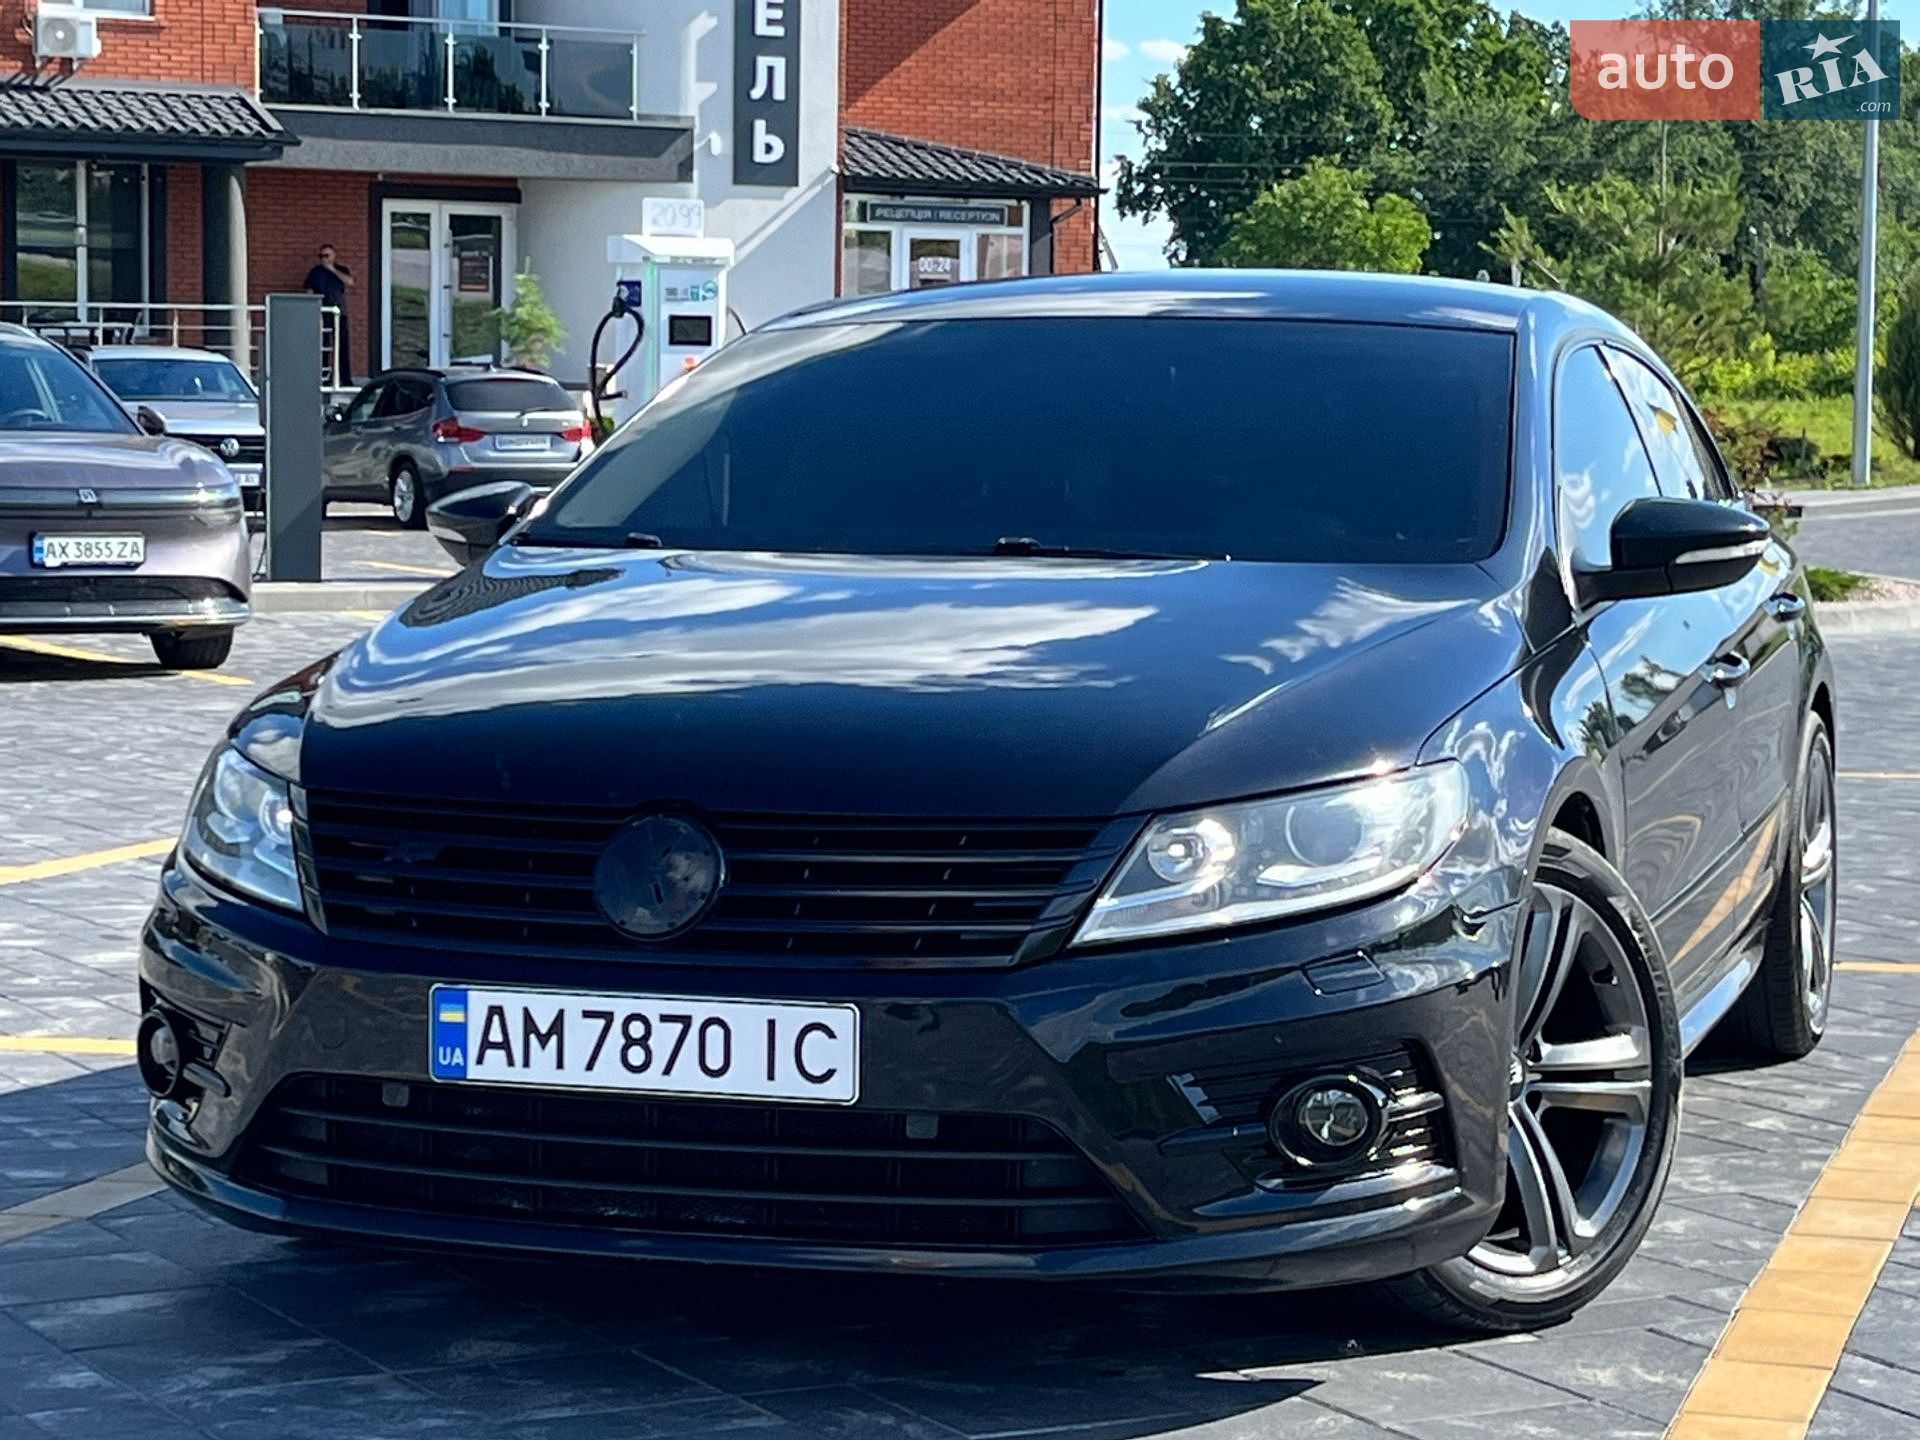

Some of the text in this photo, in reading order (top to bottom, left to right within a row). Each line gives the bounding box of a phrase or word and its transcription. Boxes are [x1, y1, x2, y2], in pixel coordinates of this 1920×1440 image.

[939, 209, 1000, 221] RECEPTION
[45, 542, 141, 558] AX 3855 ZA
[475, 1005, 837, 1085] AM 7870 IC
[438, 1046, 464, 1066] UA
